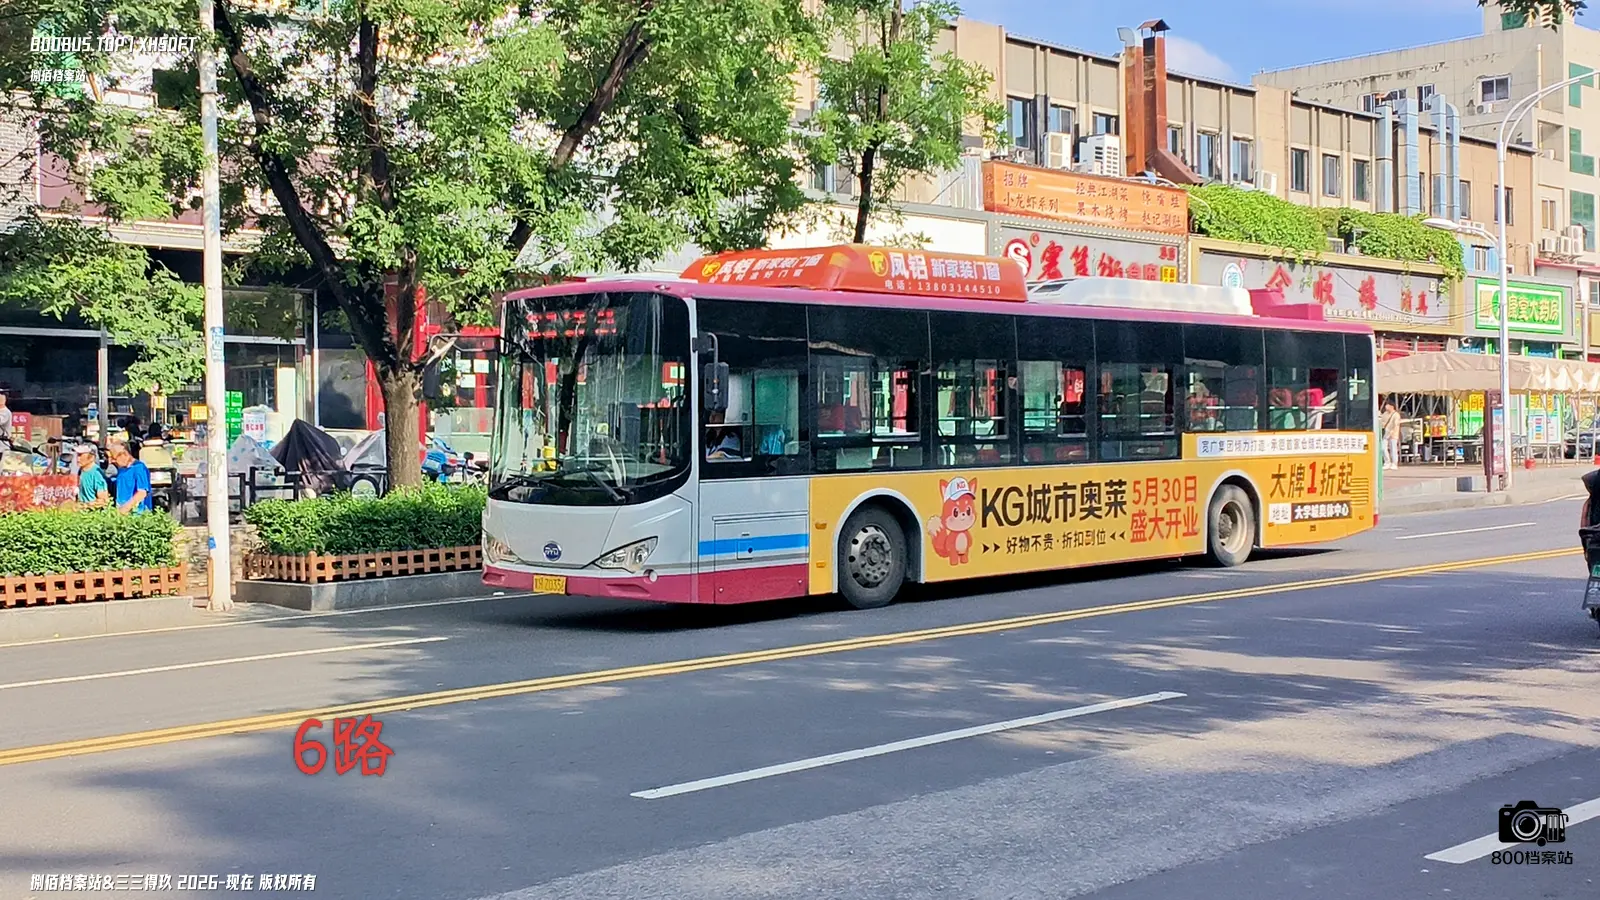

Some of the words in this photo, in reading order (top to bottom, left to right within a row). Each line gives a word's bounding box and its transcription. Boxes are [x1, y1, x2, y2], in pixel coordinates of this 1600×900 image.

[1003, 170, 1028, 188] 招牌
[1075, 181, 1129, 201] 经典江湖菜
[1003, 191, 1059, 213] 小龙虾系列
[1076, 201, 1128, 222] 果木烧烤
[889, 251, 929, 280] 凤铝
[930, 258, 1001, 281] 新家装门窗
[1131, 475, 1198, 506] 5月30日
[1270, 461, 1353, 499] 大牌1折起
[981, 478, 1128, 529] KG城市奥莱
[1129, 505, 1200, 544] 盛大开业
